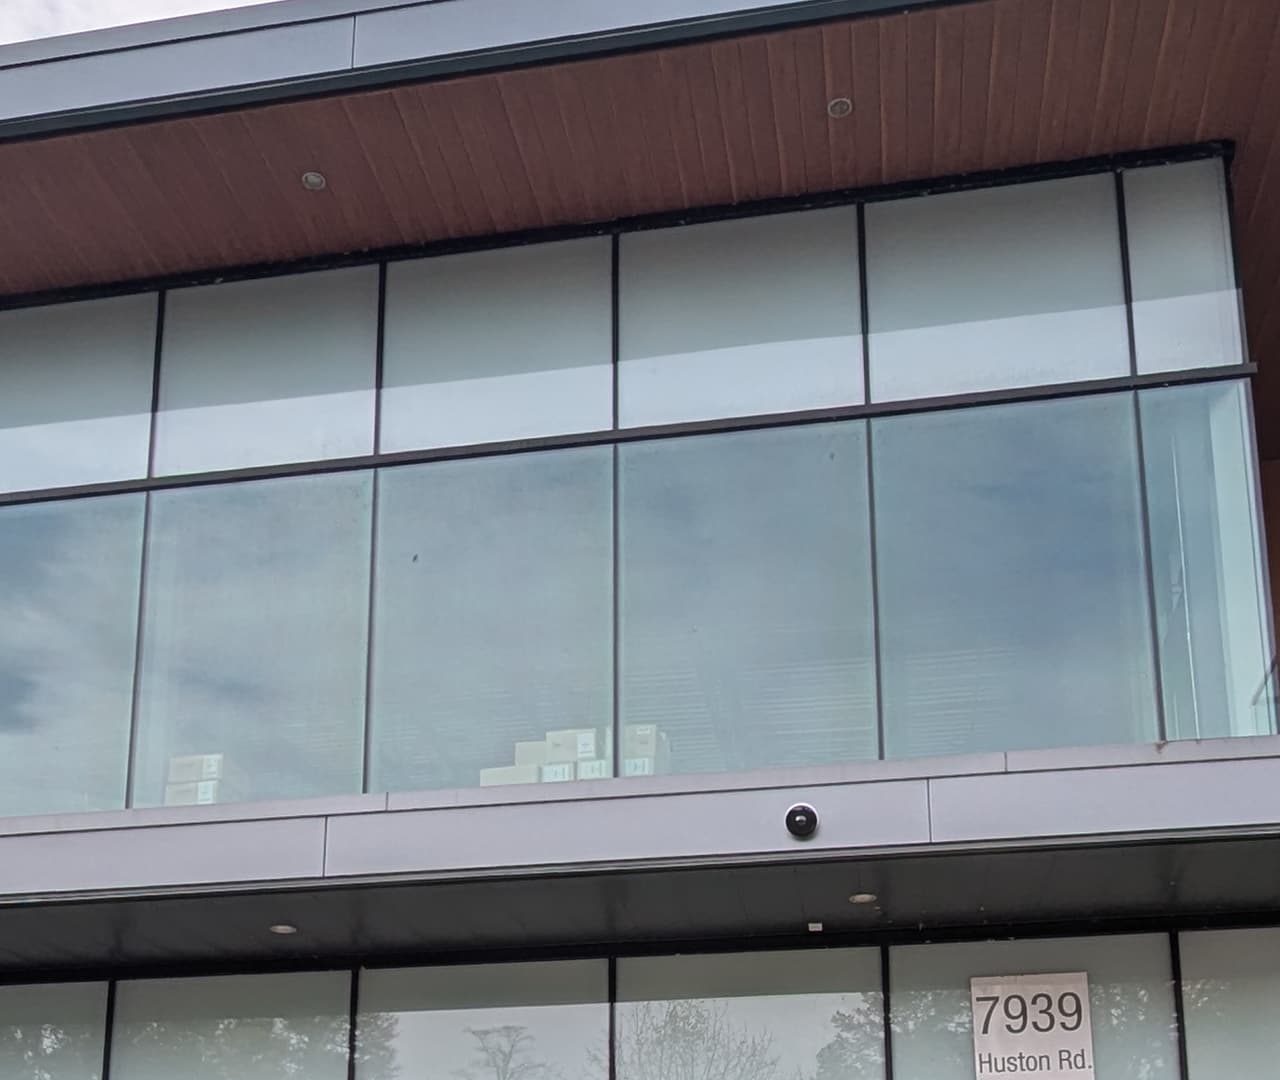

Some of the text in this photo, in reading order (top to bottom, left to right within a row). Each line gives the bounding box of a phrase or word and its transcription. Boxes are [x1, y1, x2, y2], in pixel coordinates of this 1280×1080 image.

[975, 992, 1083, 1035] 7939
[978, 1048, 1093, 1073] Huston Rd.
